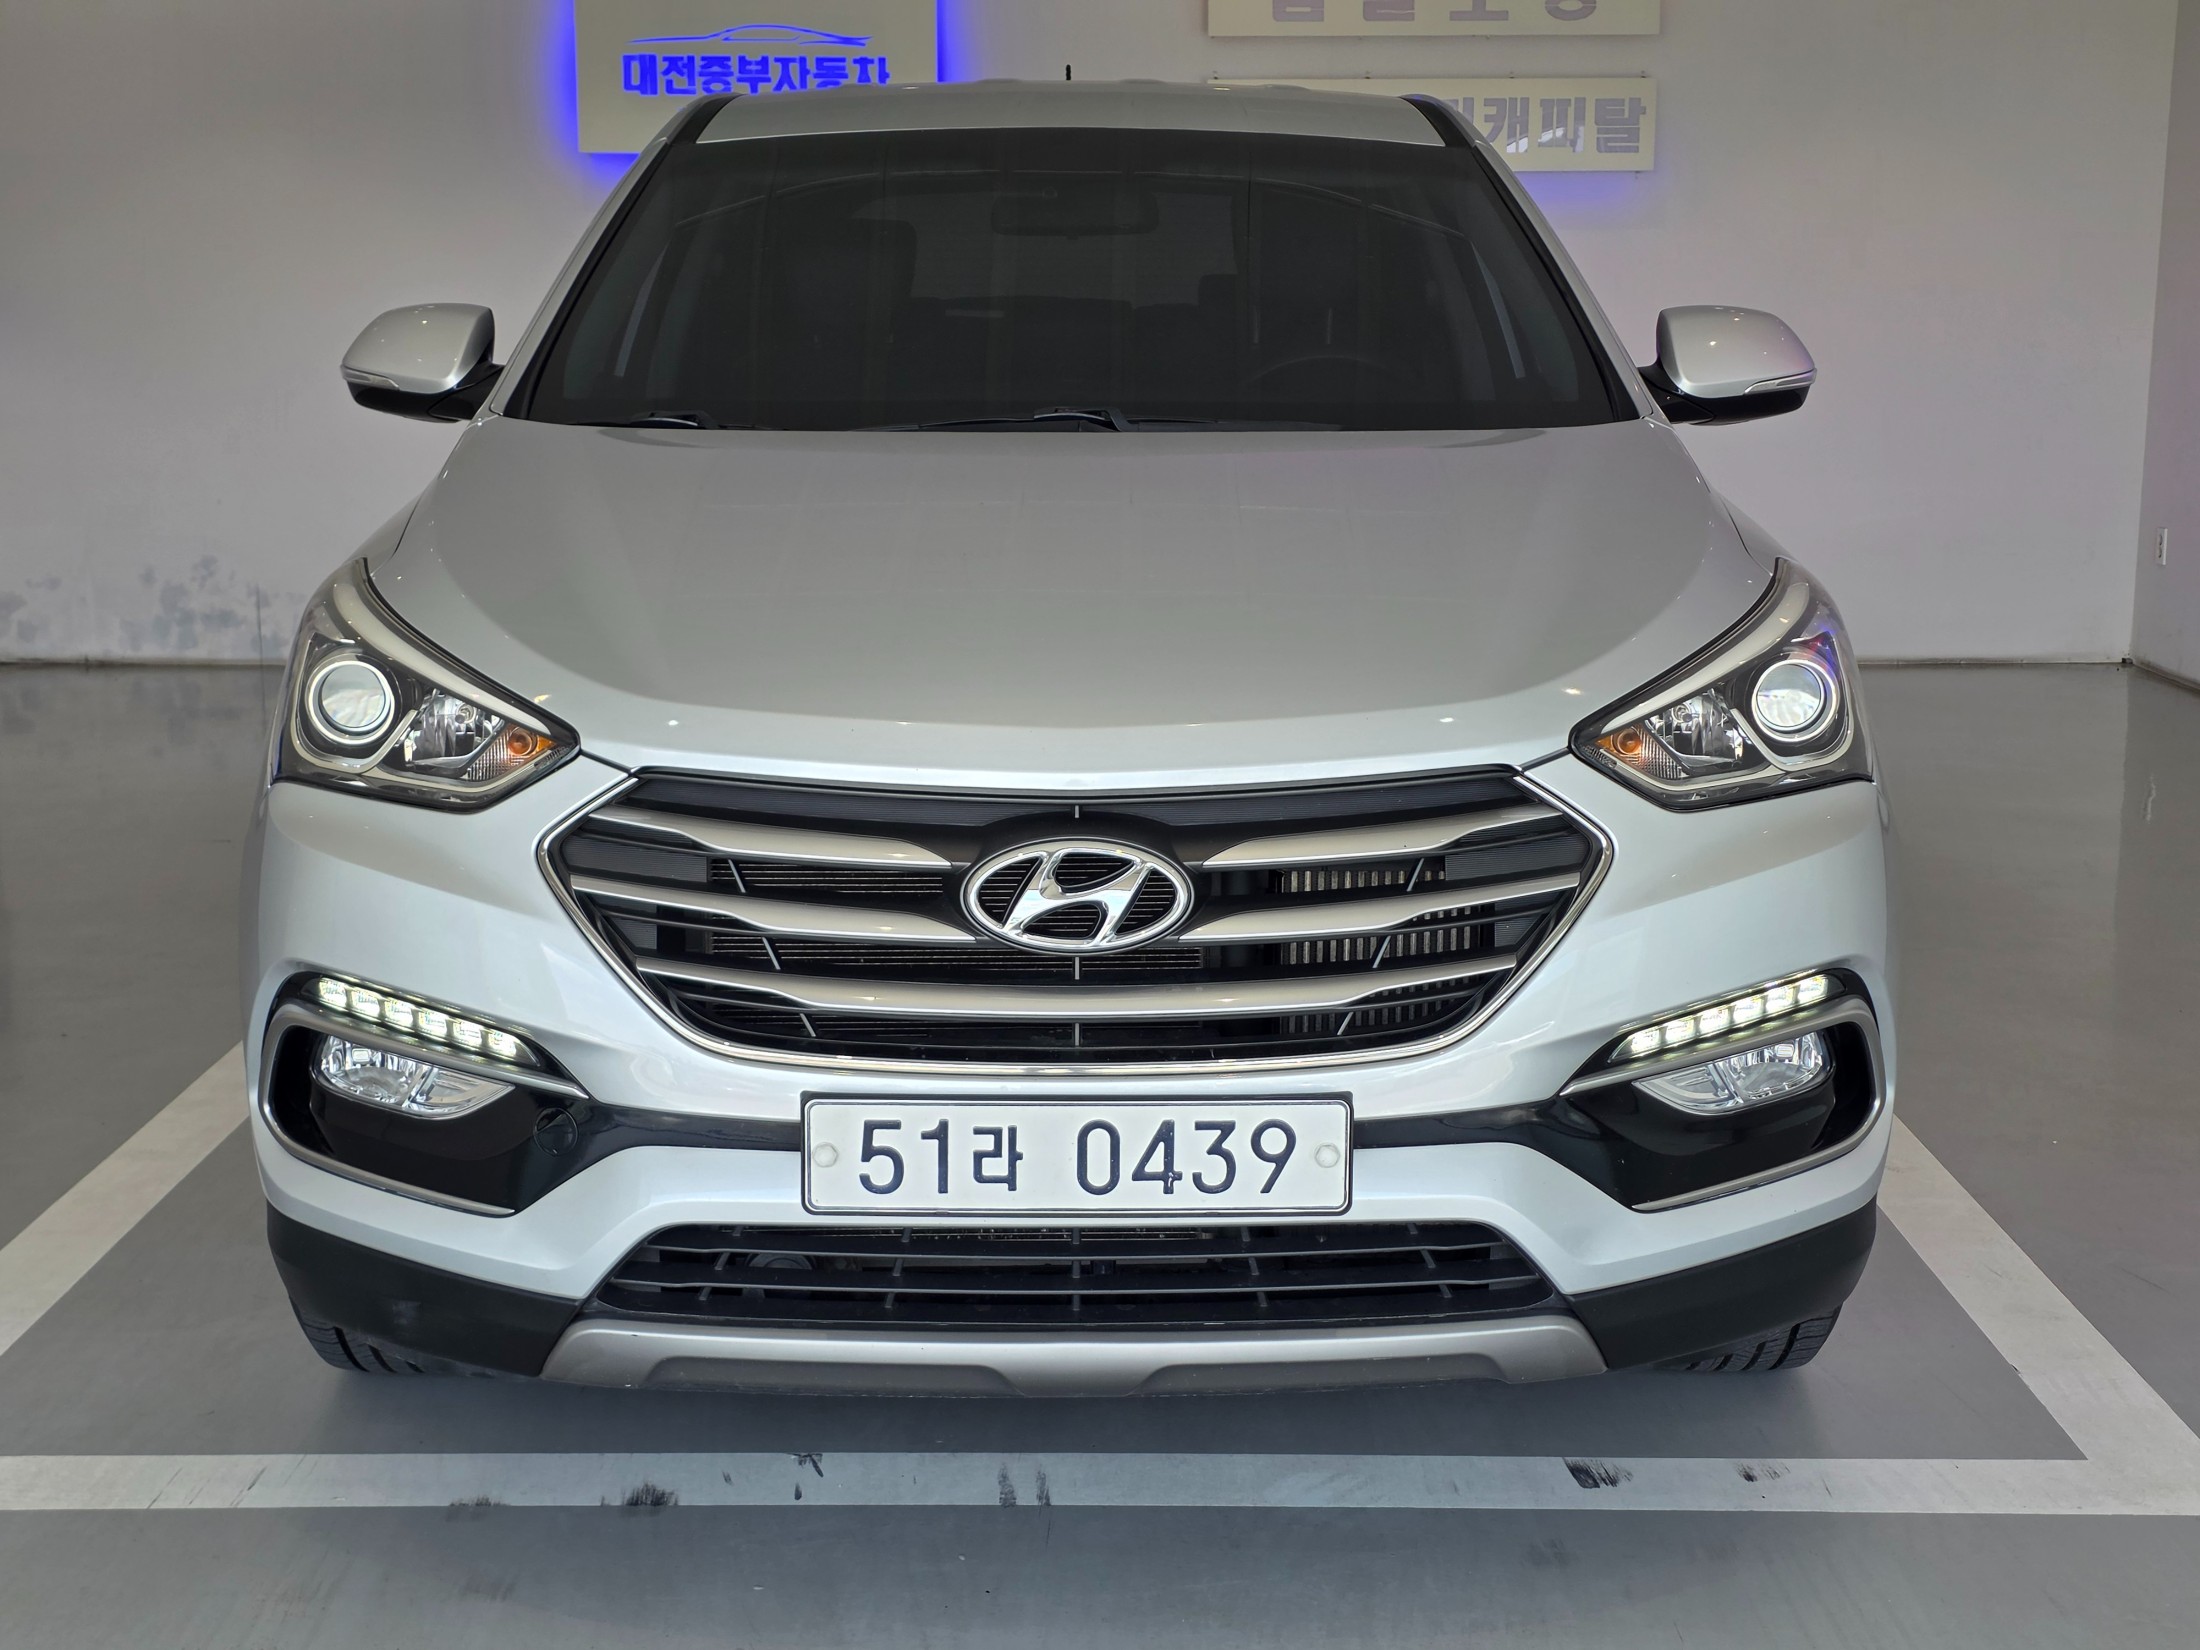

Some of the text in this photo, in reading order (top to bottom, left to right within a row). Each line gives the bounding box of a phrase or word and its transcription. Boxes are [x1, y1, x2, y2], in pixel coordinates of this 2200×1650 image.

[621, 53, 890, 96] 대전중부자동차
[858, 1118, 1297, 1195] 51라 0439
